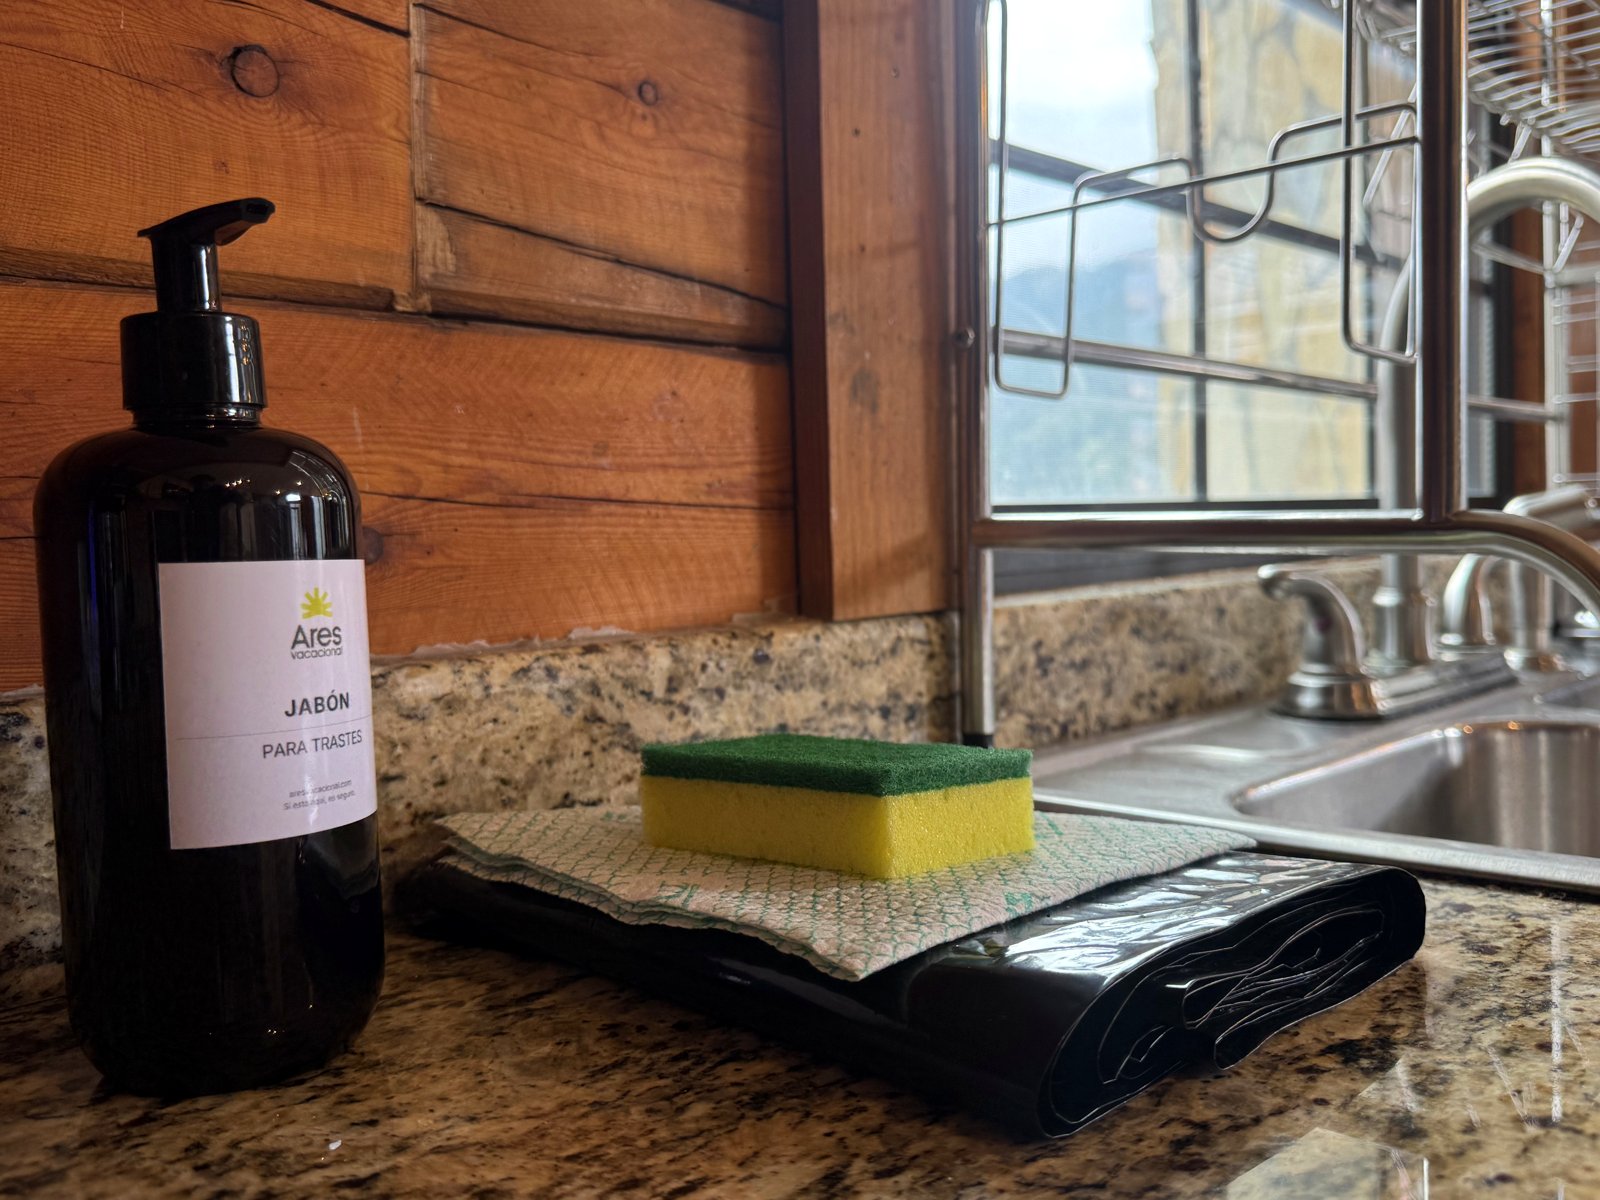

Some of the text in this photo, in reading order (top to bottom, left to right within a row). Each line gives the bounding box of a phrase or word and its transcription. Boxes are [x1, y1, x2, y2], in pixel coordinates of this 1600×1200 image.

[291, 624, 342, 649] Ares
[290, 646, 343, 660] vacacional
[285, 689, 349, 717] JABÓN
[263, 729, 363, 759] PARA TRASTES
